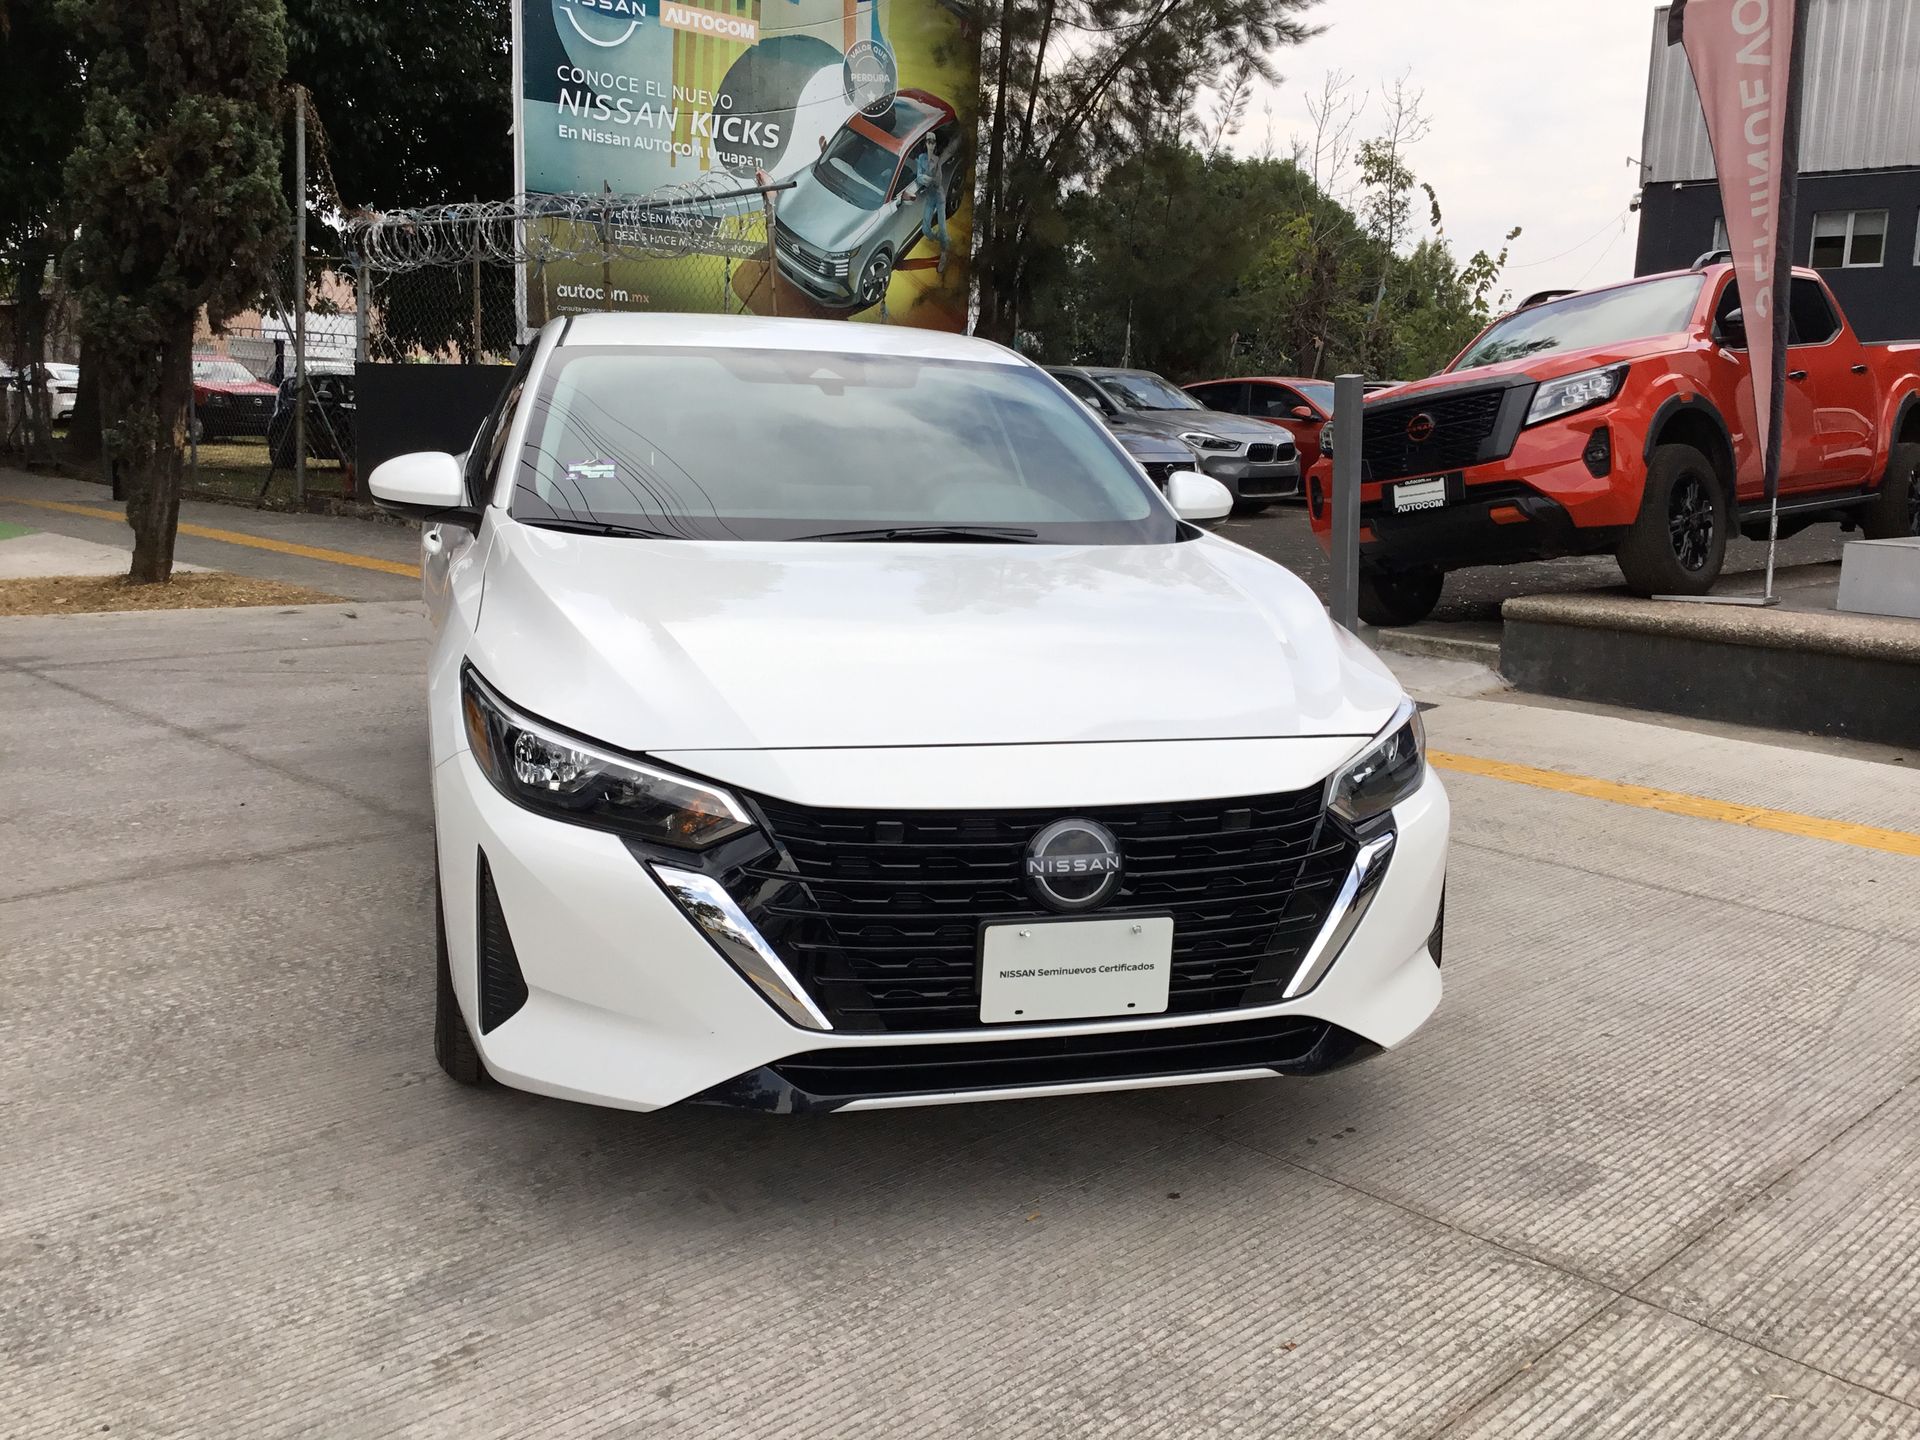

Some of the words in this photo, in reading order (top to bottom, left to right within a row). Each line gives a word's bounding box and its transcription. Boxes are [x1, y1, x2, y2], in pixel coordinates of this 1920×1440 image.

[566, 0, 646, 17] SSAN
[664, 7, 755, 39] AUTOCOM
[850, 44, 872, 59] VALOR
[873, 46, 888, 61] QUE
[851, 73, 890, 82] PERDURA
[556, 65, 639, 93] CONOCE
[645, 80, 667, 98] EL
[672, 85, 733, 110] NUEVO
[557, 88, 679, 132] NISSAN
[690, 110, 780, 149] KICKS
[558, 124, 577, 140] En
[581, 127, 631, 147] Nissan
[634, 135, 703, 158] AUTOCOM
[650, 213, 663, 224] EN
[650, 233, 677, 246] HACE
[679, 236, 700, 249] MS
[1398, 499, 1444, 513] AUTOCOM
[1029, 856, 1120, 874] NISSAN
[999, 969, 1036, 979] NISSAN
[1038, 965, 1097, 977] Seminuevos
[1099, 963, 1155, 973] Certificados
